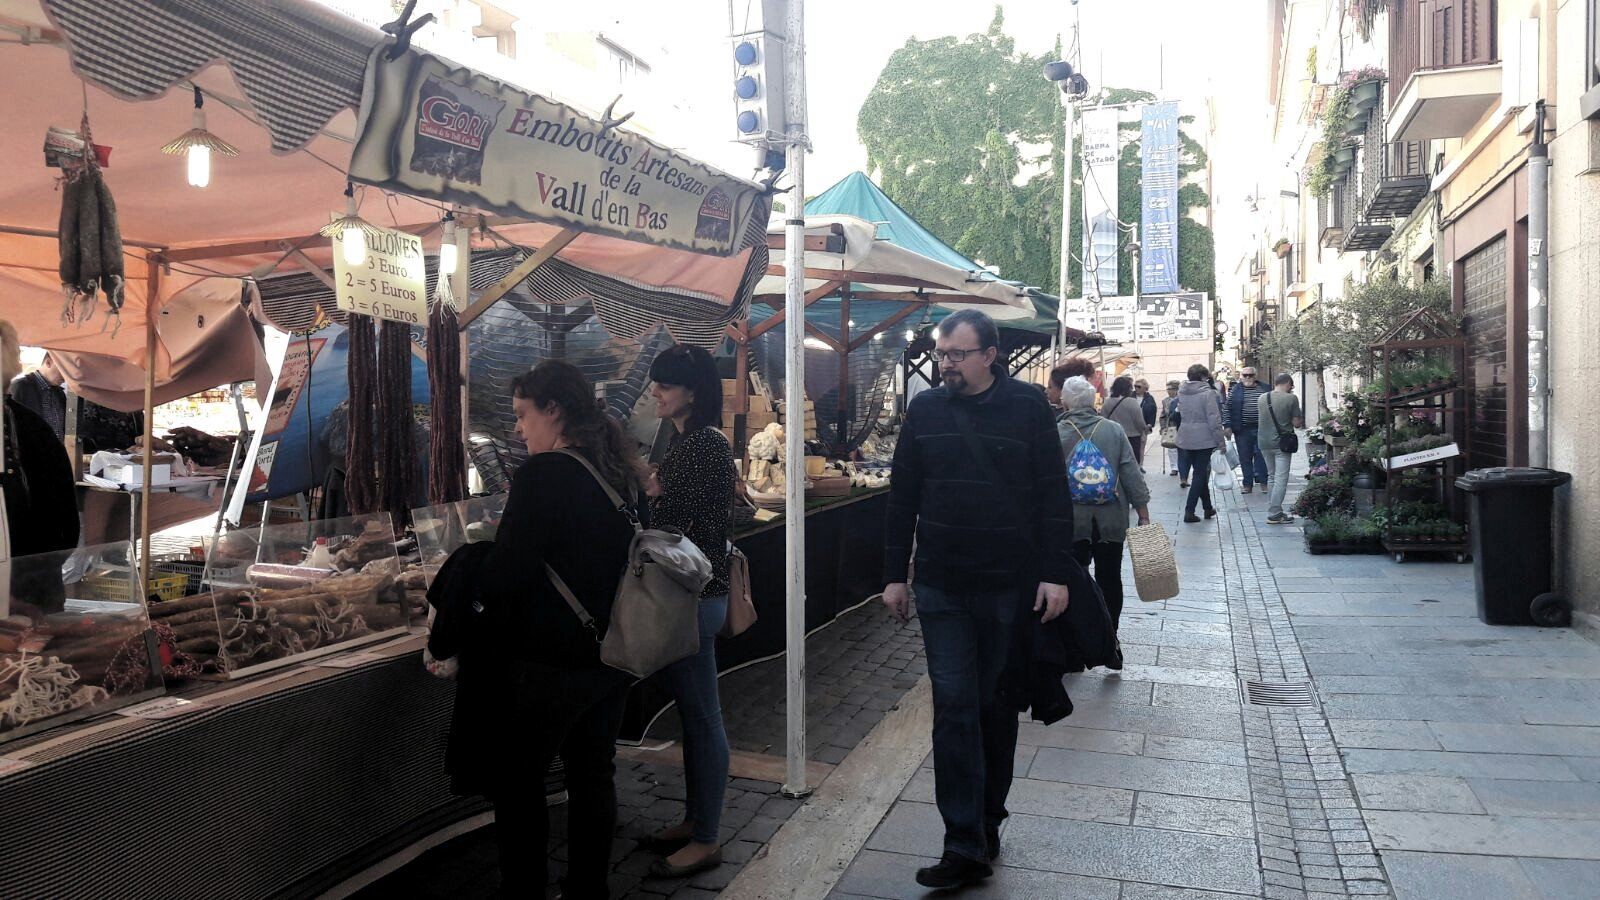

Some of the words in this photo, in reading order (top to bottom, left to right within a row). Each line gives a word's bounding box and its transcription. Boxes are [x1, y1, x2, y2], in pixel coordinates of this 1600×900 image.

[422, 96, 488, 137] GORI
[506, 108, 632, 165] Embotits
[631, 147, 707, 196] Artesans
[600, 167, 620, 189] de
[623, 175, 641, 196] la
[536, 172, 587, 216] Vall
[592, 190, 629, 226] d'en
[636, 203, 668, 230] Bas
[368, 255, 375, 270] 3
[378, 257, 412, 279] Euro
[345, 272, 354, 287] 2
[370, 278, 377, 292] 5
[380, 281, 416, 301] Euros
[347, 295, 355, 310] 3
[372, 301, 380, 316] 6
[383, 303, 418, 323] Euros
